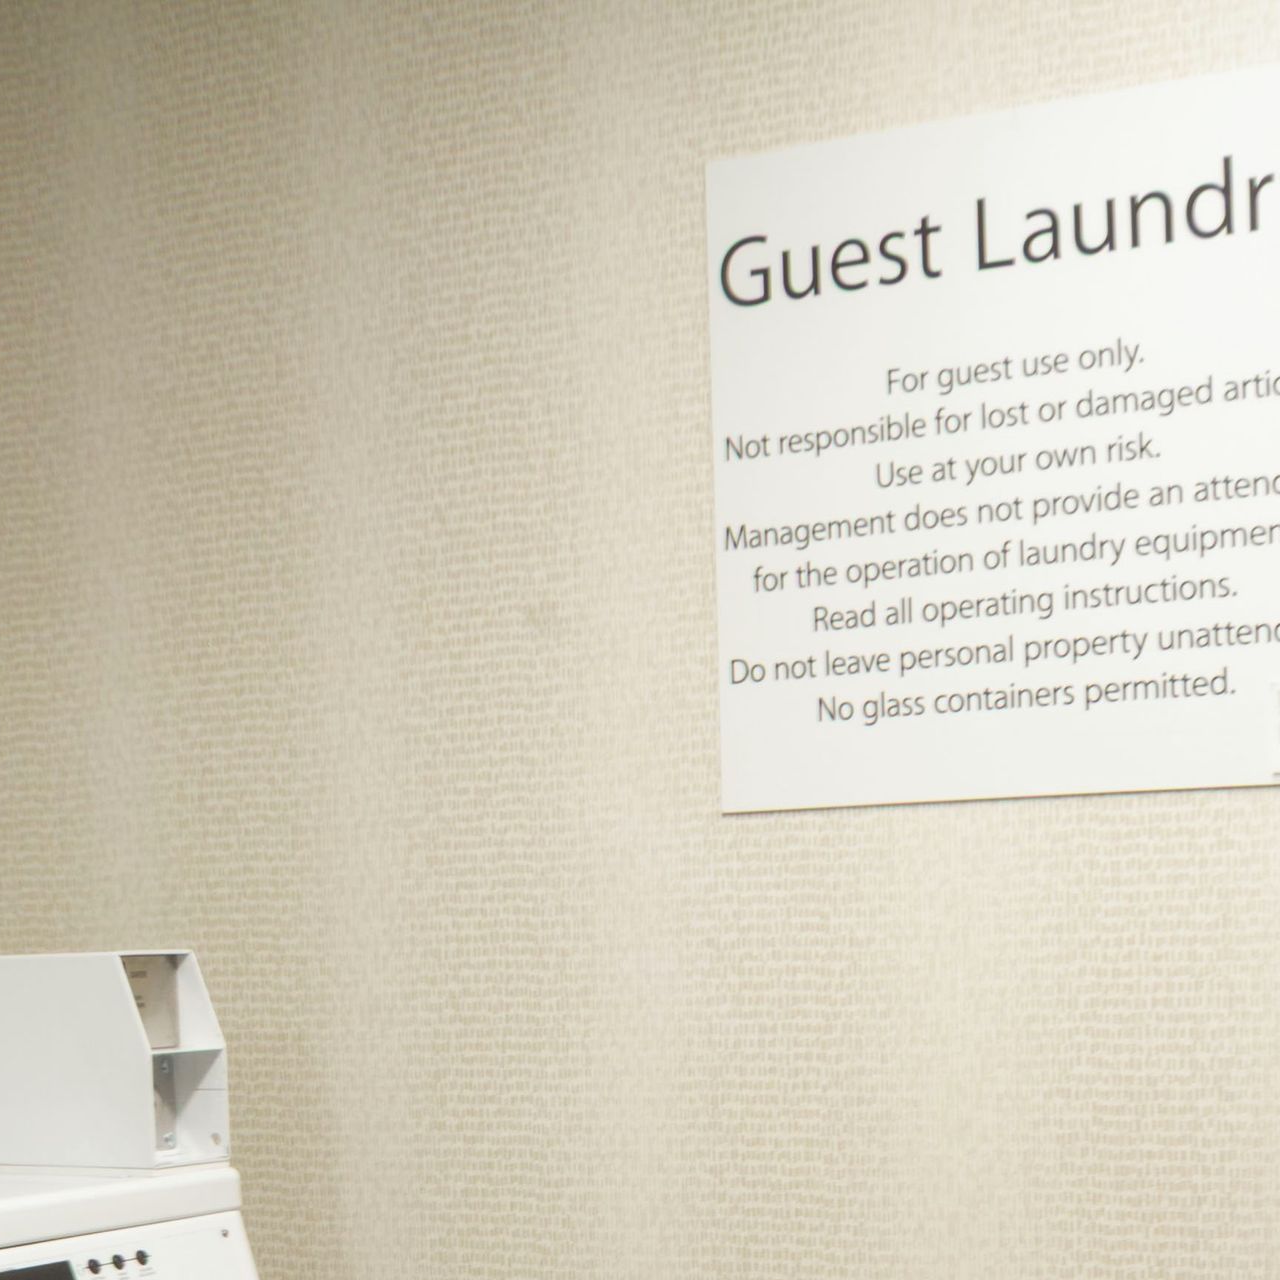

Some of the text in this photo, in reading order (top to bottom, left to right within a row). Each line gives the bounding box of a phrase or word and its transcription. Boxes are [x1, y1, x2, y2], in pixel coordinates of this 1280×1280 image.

[719, 214, 943, 308] Guest
[887, 337, 1145, 396] For guest use only.
[725, 434, 771, 462] Not
[778, 412, 927, 457] responsible
[933, 406, 973, 436] for
[981, 401, 1029, 430] lost
[1037, 400, 1067, 423] or
[1075, 375, 1213, 419] damaged
[876, 431, 1161, 489] Use at your own risk.
[724, 510, 896, 552] Management
[903, 503, 969, 532] does
[977, 497, 1023, 524] not
[1032, 482, 1140, 526] provide
[1148, 484, 1184, 508] an
[752, 565, 789, 593] for
[795, 560, 838, 589] the
[845, 549, 974, 589] operation
[983, 539, 1012, 571] of
[1019, 532, 1126, 567] laundry
[813, 574, 1238, 632] Read all operating instructions.
[730, 658, 767, 685] Do
[774, 655, 817, 681] not
[825, 649, 891, 677] leave
[899, 634, 1014, 678] personal
[1024, 629, 1149, 668] property
[818, 666, 1236, 727] No glass containers permitted.
